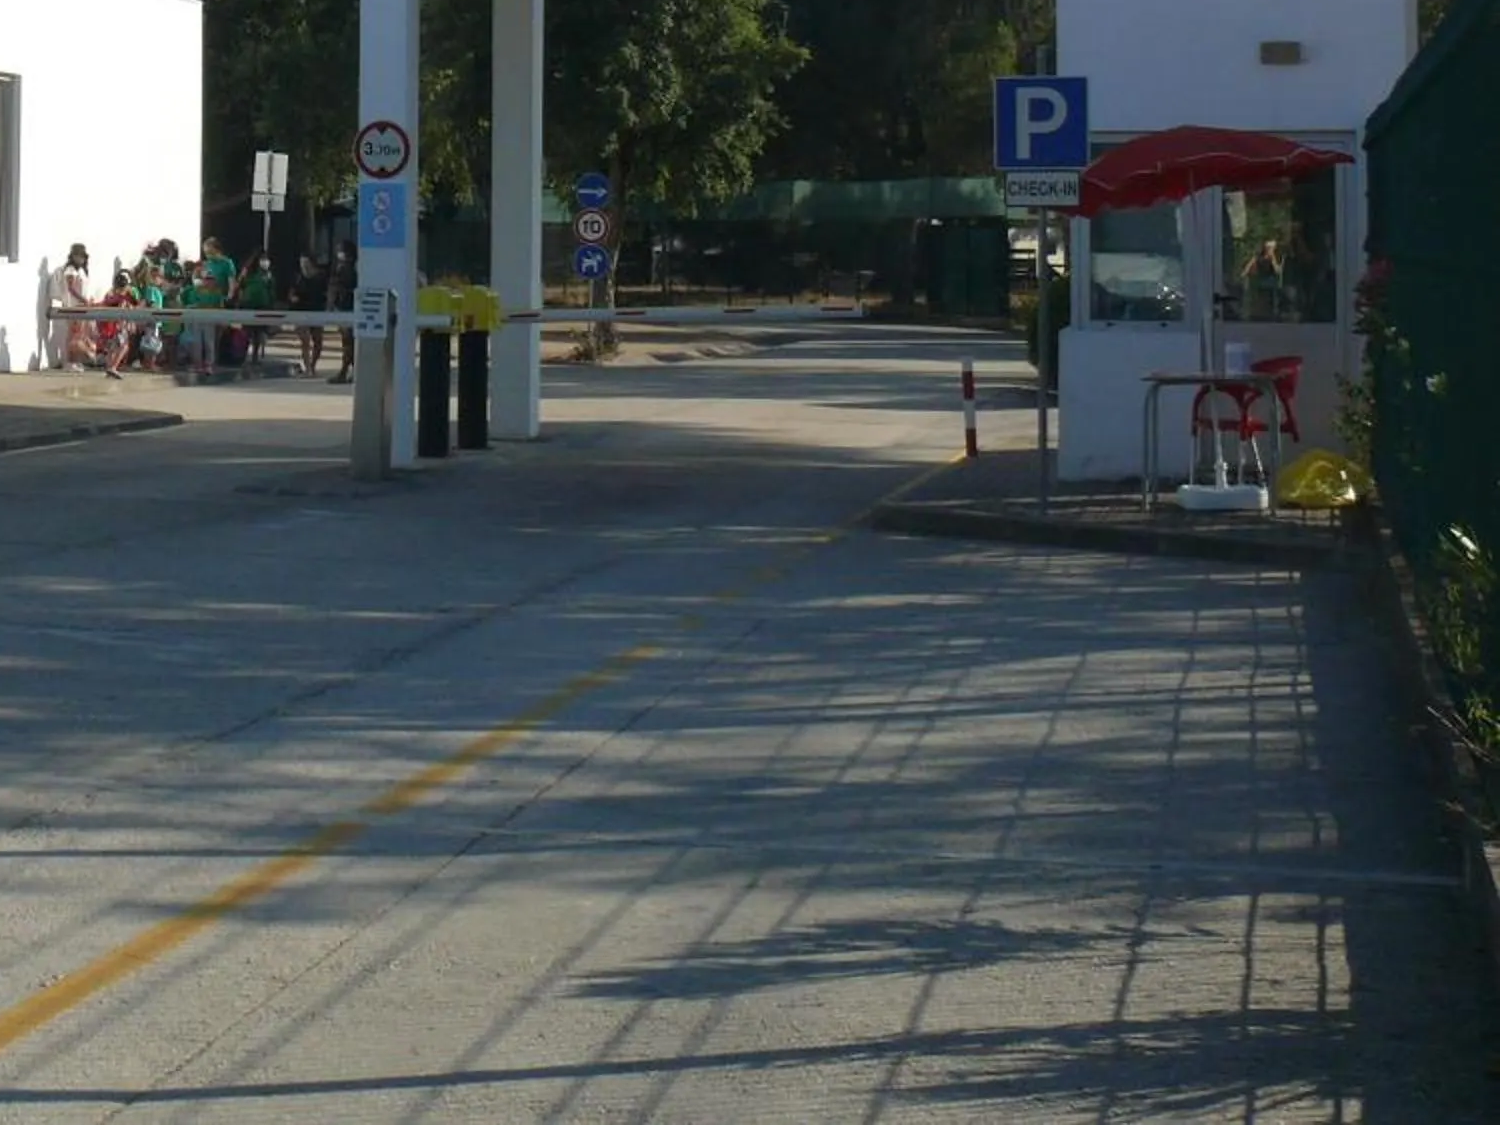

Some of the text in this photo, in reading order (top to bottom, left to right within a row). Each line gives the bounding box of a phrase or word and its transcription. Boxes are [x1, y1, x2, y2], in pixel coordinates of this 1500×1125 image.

[1015, 86, 1067, 160] P
[1008, 180, 1077, 197] CHECK-IN
[583, 220, 601, 234] 10
